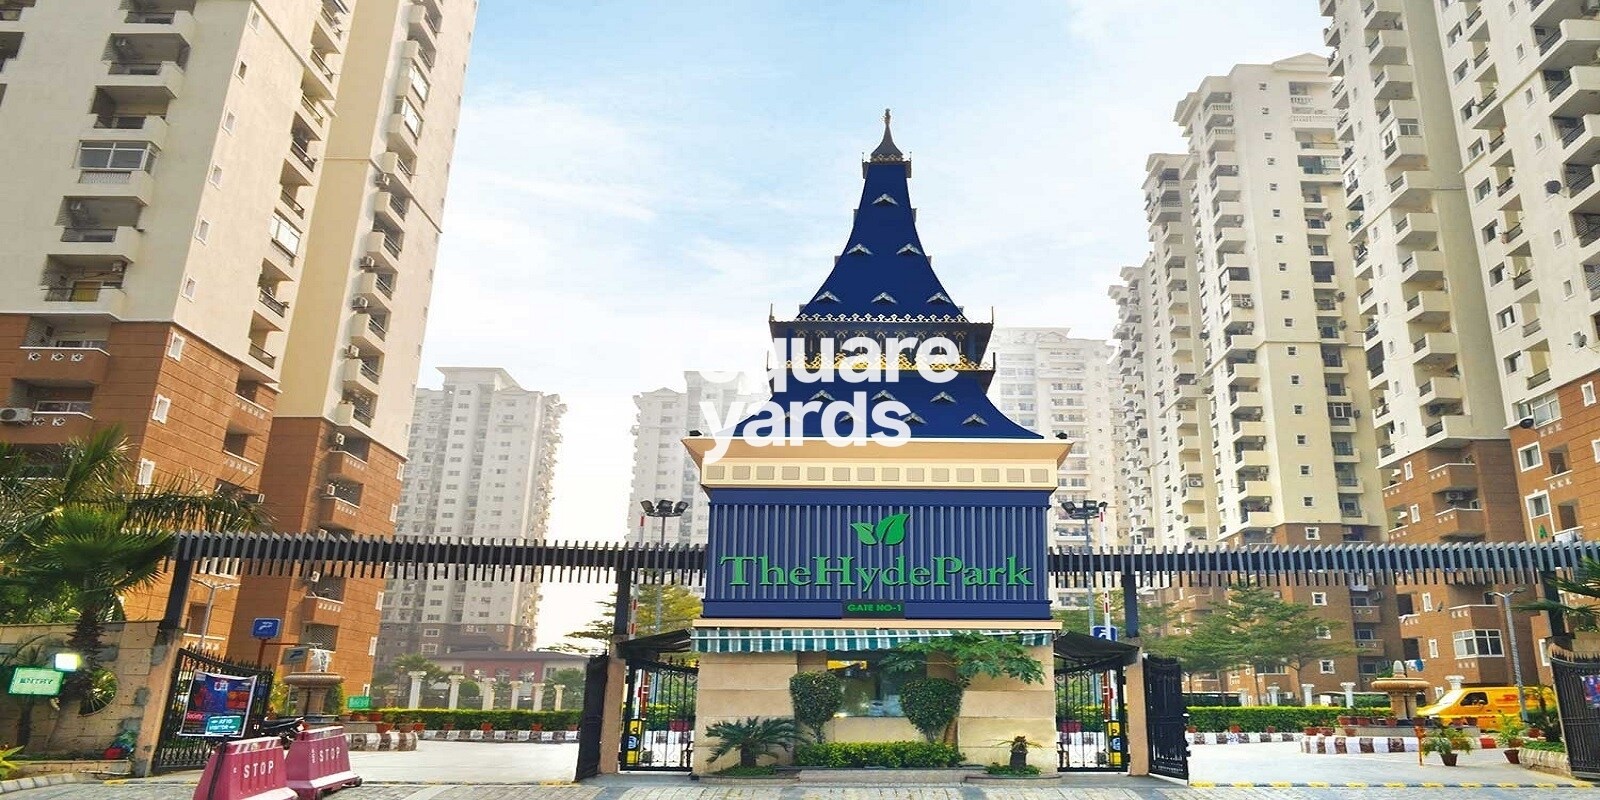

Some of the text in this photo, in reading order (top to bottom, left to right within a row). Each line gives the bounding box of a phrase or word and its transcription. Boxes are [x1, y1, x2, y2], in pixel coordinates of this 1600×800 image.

[847, 603, 902, 613] GATE NO-1
[20, 677, 54, 685] ENTRY
[319, 746, 341, 763] STOP
[243, 760, 274, 779] STOP
